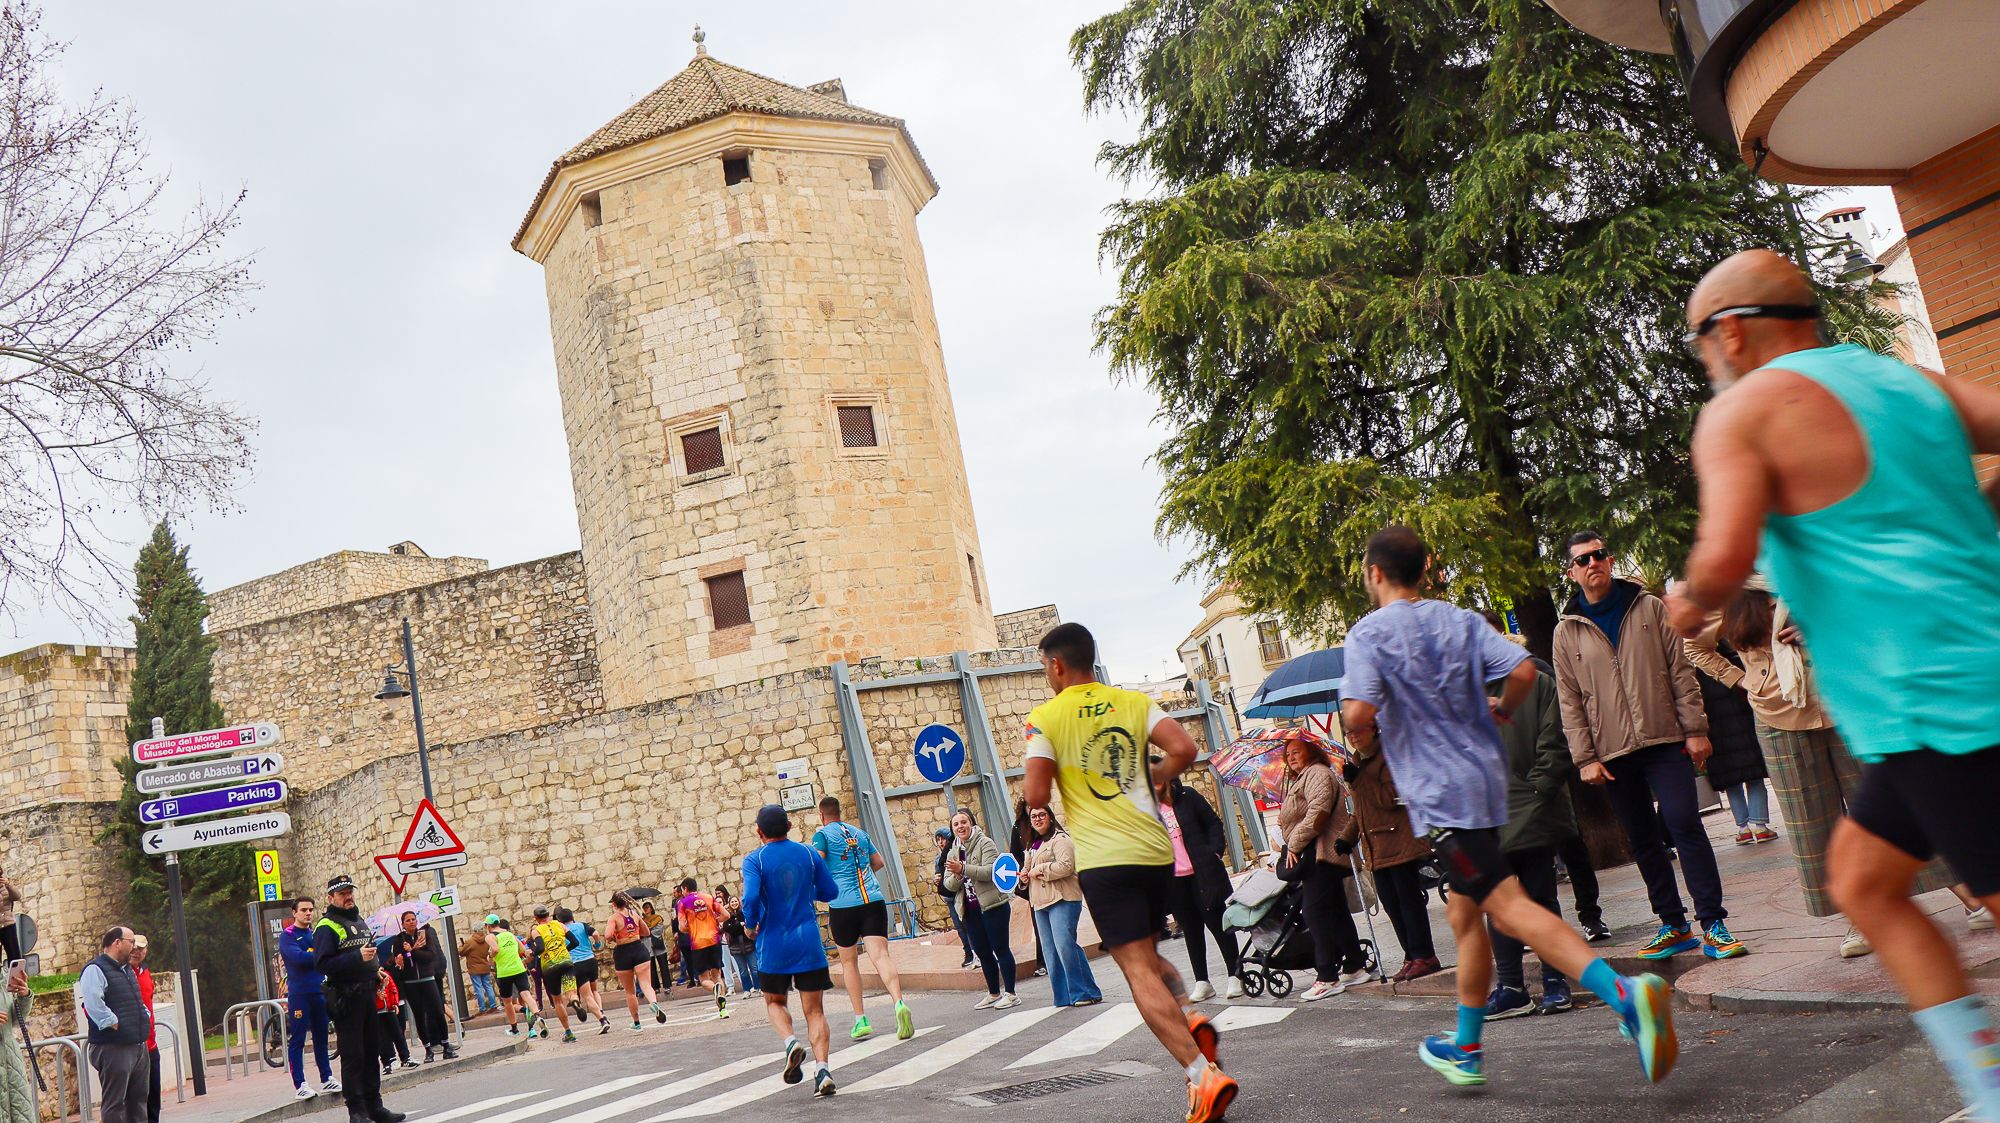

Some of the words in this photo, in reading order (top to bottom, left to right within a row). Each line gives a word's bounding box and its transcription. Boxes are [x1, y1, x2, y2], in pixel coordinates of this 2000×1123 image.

[143, 740, 176, 751] Castillo
[178, 738, 192, 746] del
[194, 733, 219, 743] Moral
[143, 749, 174, 758] Museo
[175, 740, 234, 753] Arqueológico
[145, 771, 187, 787] Mercado
[189, 769, 201, 780] de
[203, 764, 242, 778] Abastos
[246, 760, 258, 773] P
[228, 787, 276, 802] Parking
[193, 819, 279, 841] Ayuntamiento
